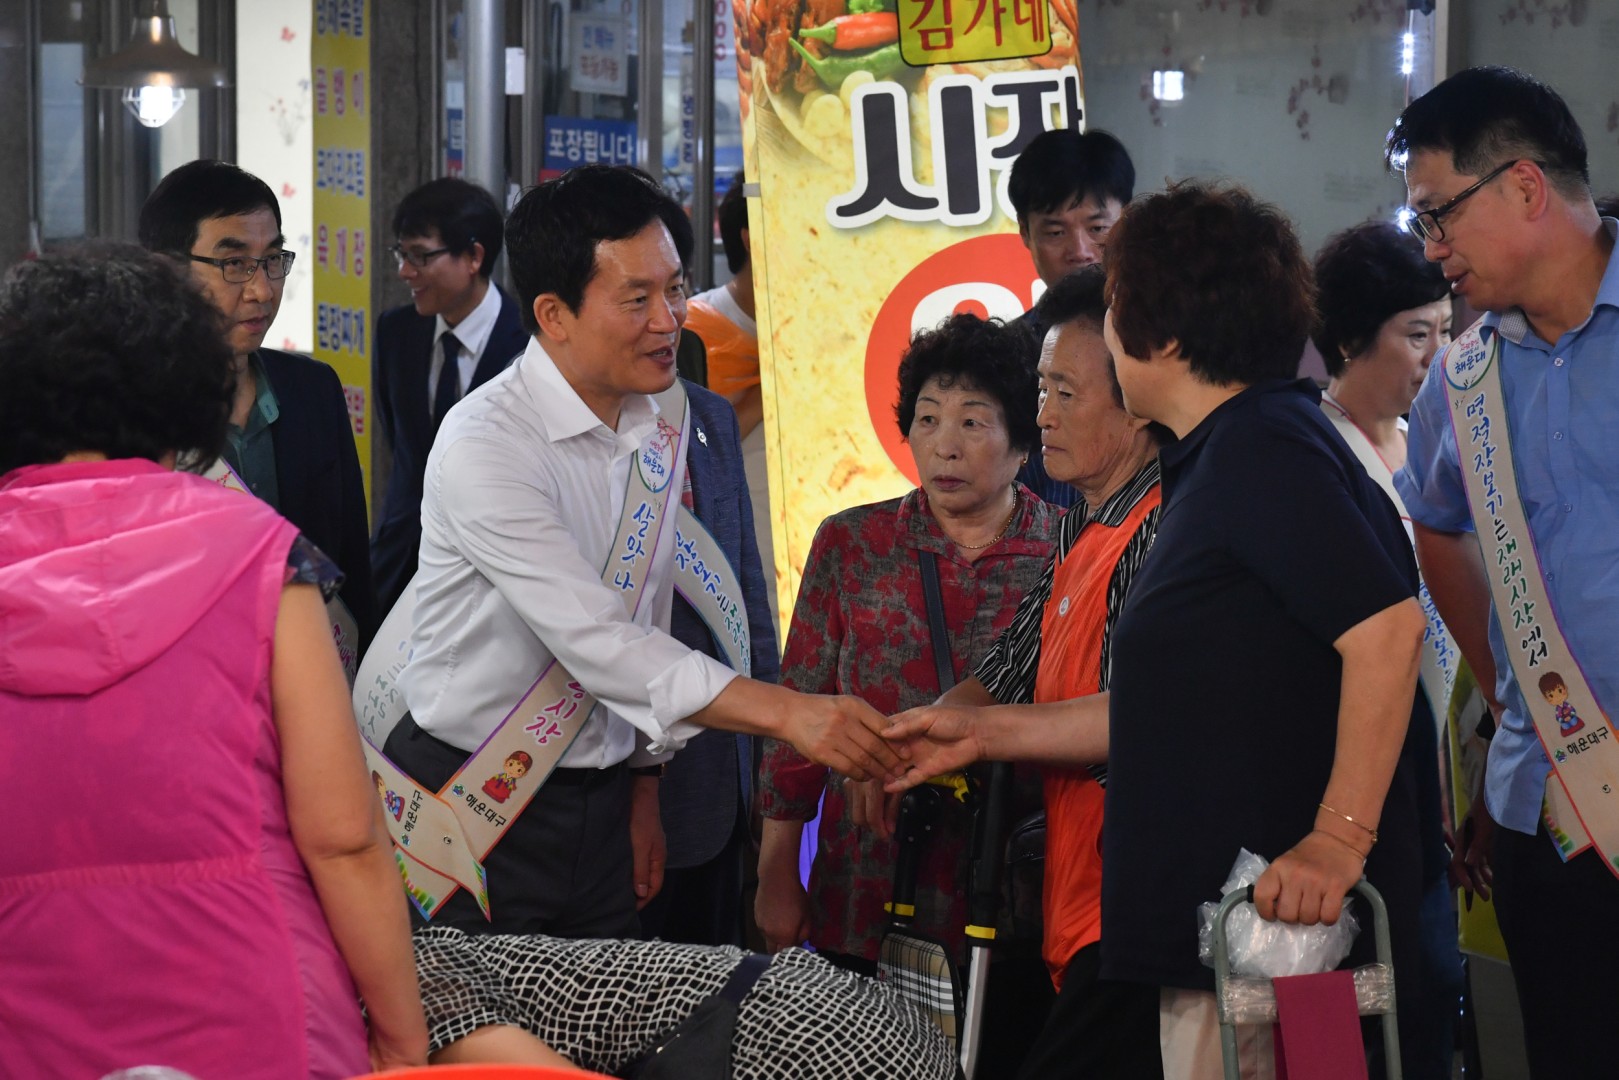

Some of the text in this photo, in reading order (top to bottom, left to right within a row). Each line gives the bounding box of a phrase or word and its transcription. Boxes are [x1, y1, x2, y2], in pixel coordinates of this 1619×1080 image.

[909, 0, 1045, 51] 김가네
[548, 128, 634, 166] 포장됩니다
[317, 223, 365, 277] 육개장
[318, 303, 365, 358] 된장찌개
[1455, 349, 1486, 375] 해운대
[642, 452, 666, 478] 해운대
[1567, 725, 1610, 757] 해운대구
[403, 788, 425, 834] 해운대구
[464, 793, 508, 828] 해운대구
